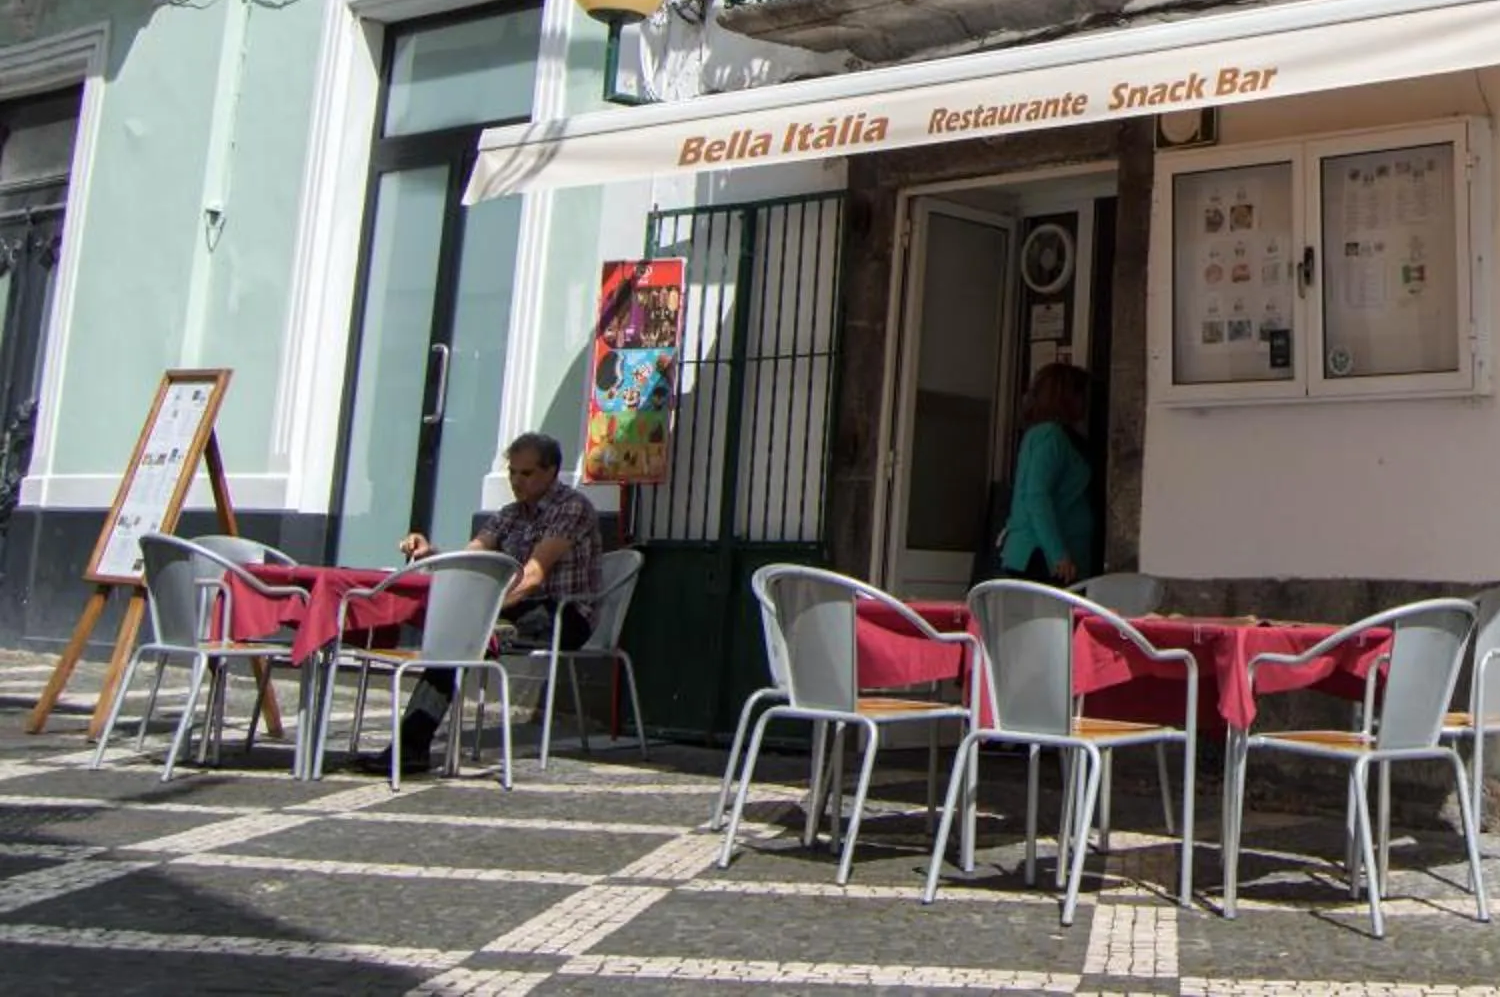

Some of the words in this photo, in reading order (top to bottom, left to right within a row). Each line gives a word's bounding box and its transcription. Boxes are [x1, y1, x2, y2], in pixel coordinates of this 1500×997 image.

[677, 129, 773, 167] Bella
[782, 112, 890, 154] Itália
[927, 92, 1089, 135] Restaurante
[1107, 73, 1206, 111] Snack
[1215, 65, 1279, 98] Bar
